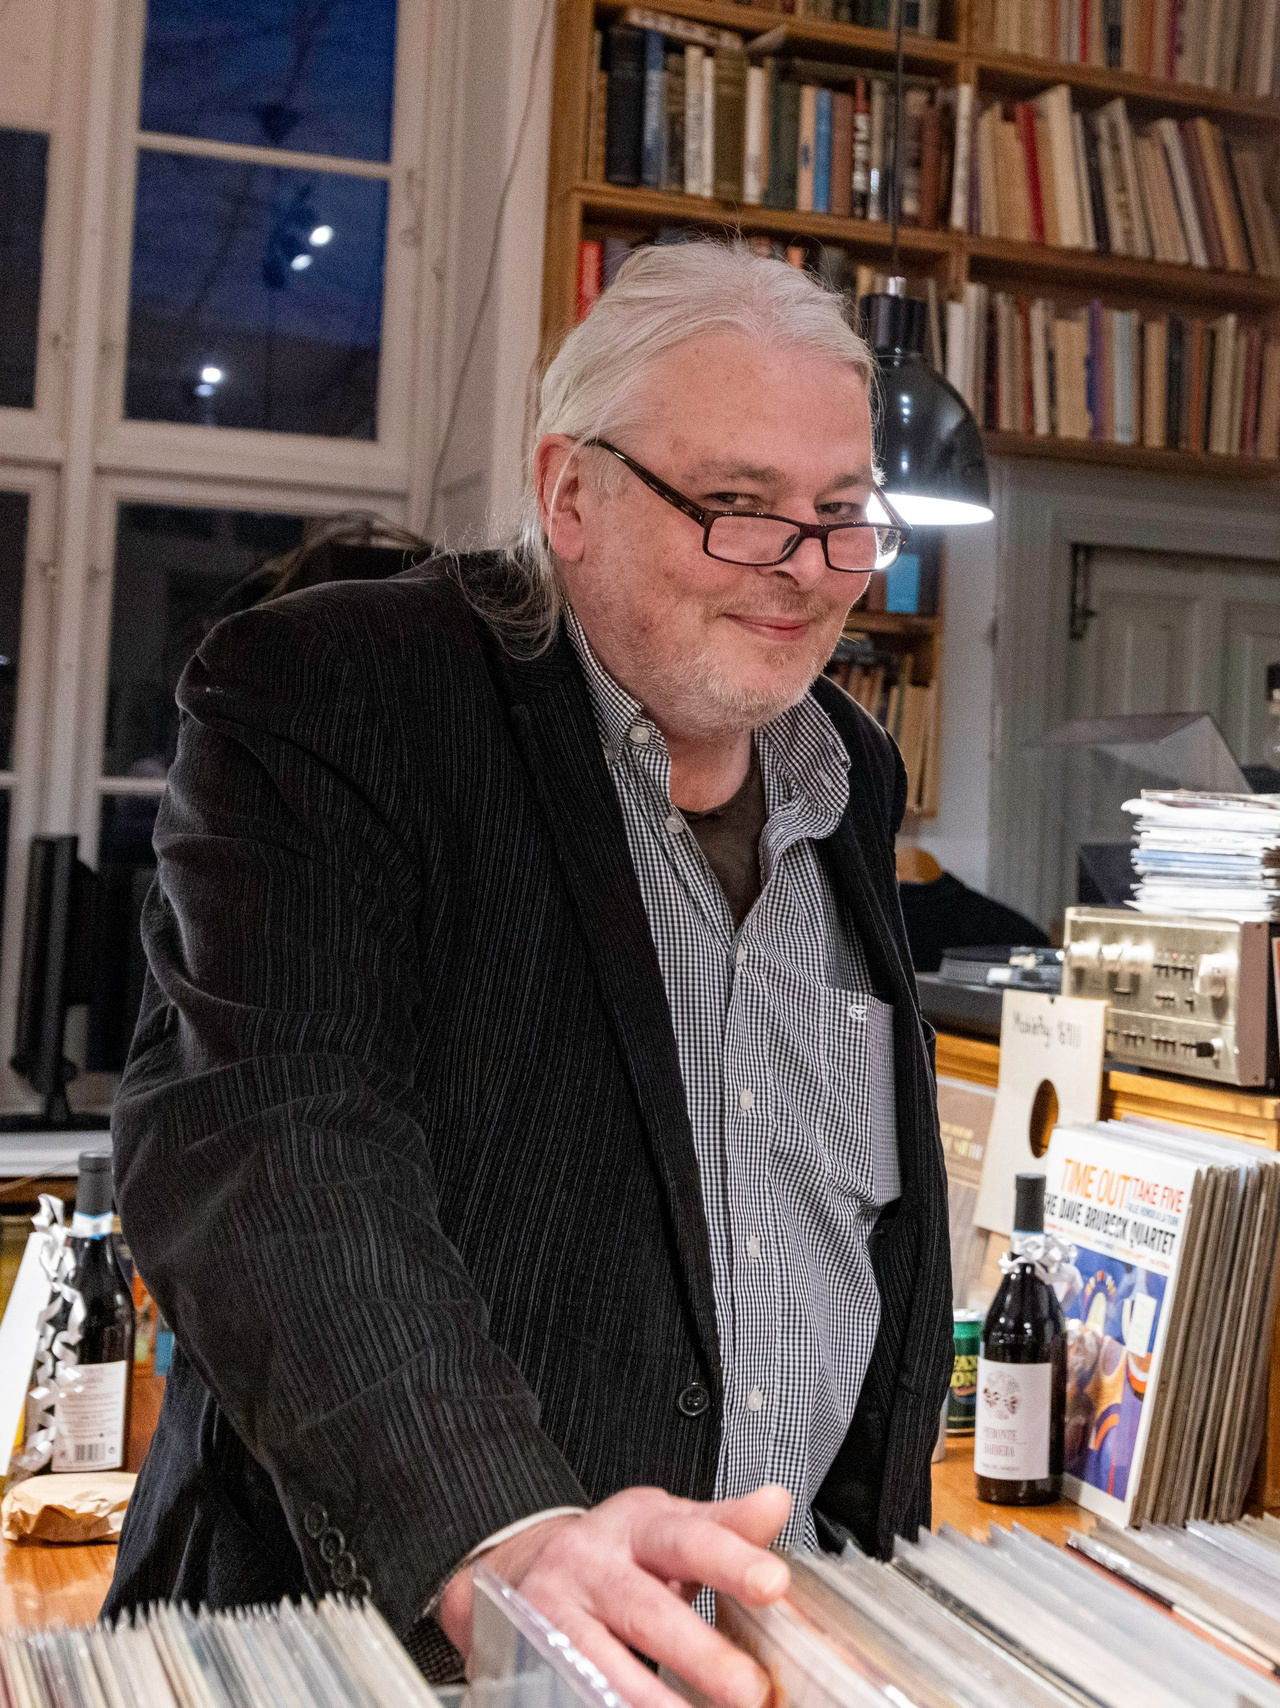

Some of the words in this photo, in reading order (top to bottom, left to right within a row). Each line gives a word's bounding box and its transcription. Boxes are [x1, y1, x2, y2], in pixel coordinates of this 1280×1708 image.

[1061, 1158, 1097, 1199] TIME
[1097, 1169, 1131, 1208] OUT
[1132, 1177, 1160, 1206] TAKE
[1160, 1186, 1185, 1213] FIVE
[1059, 1198, 1084, 1225] DAVE
[1130, 1221, 1177, 1256] QUARTET
